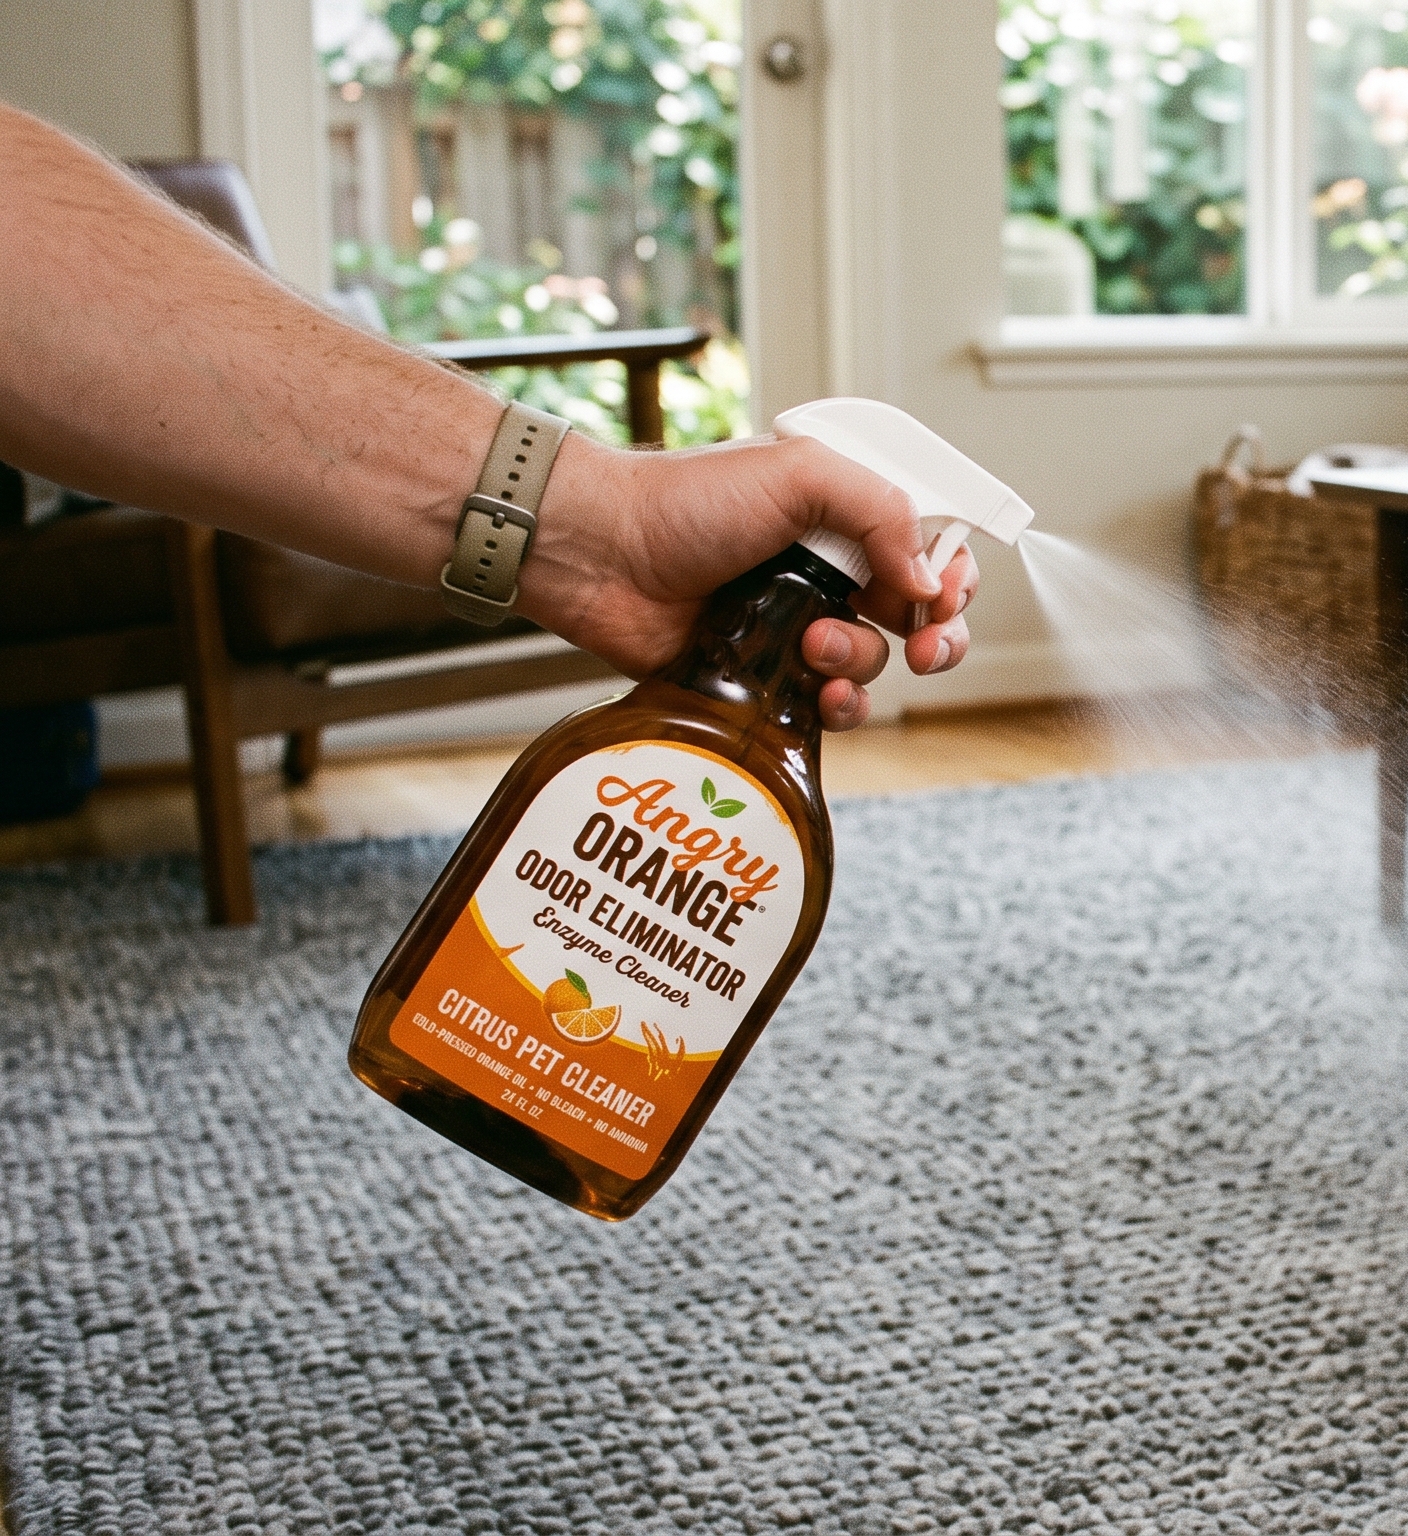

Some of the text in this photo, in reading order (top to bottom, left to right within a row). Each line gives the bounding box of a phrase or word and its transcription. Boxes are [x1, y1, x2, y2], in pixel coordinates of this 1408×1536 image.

[573, 811, 758, 947] ORANGE
[596, 775, 780, 903] Angry
[515, 849, 747, 1002] ODOR ELIMINATOR
[533, 906, 690, 1009] Enzyme Cleaner
[437, 988, 656, 1128] CITRUS PET CLEANER
[511, 1073, 528, 1090] OIL
[534, 1086, 552, 1102] NO
